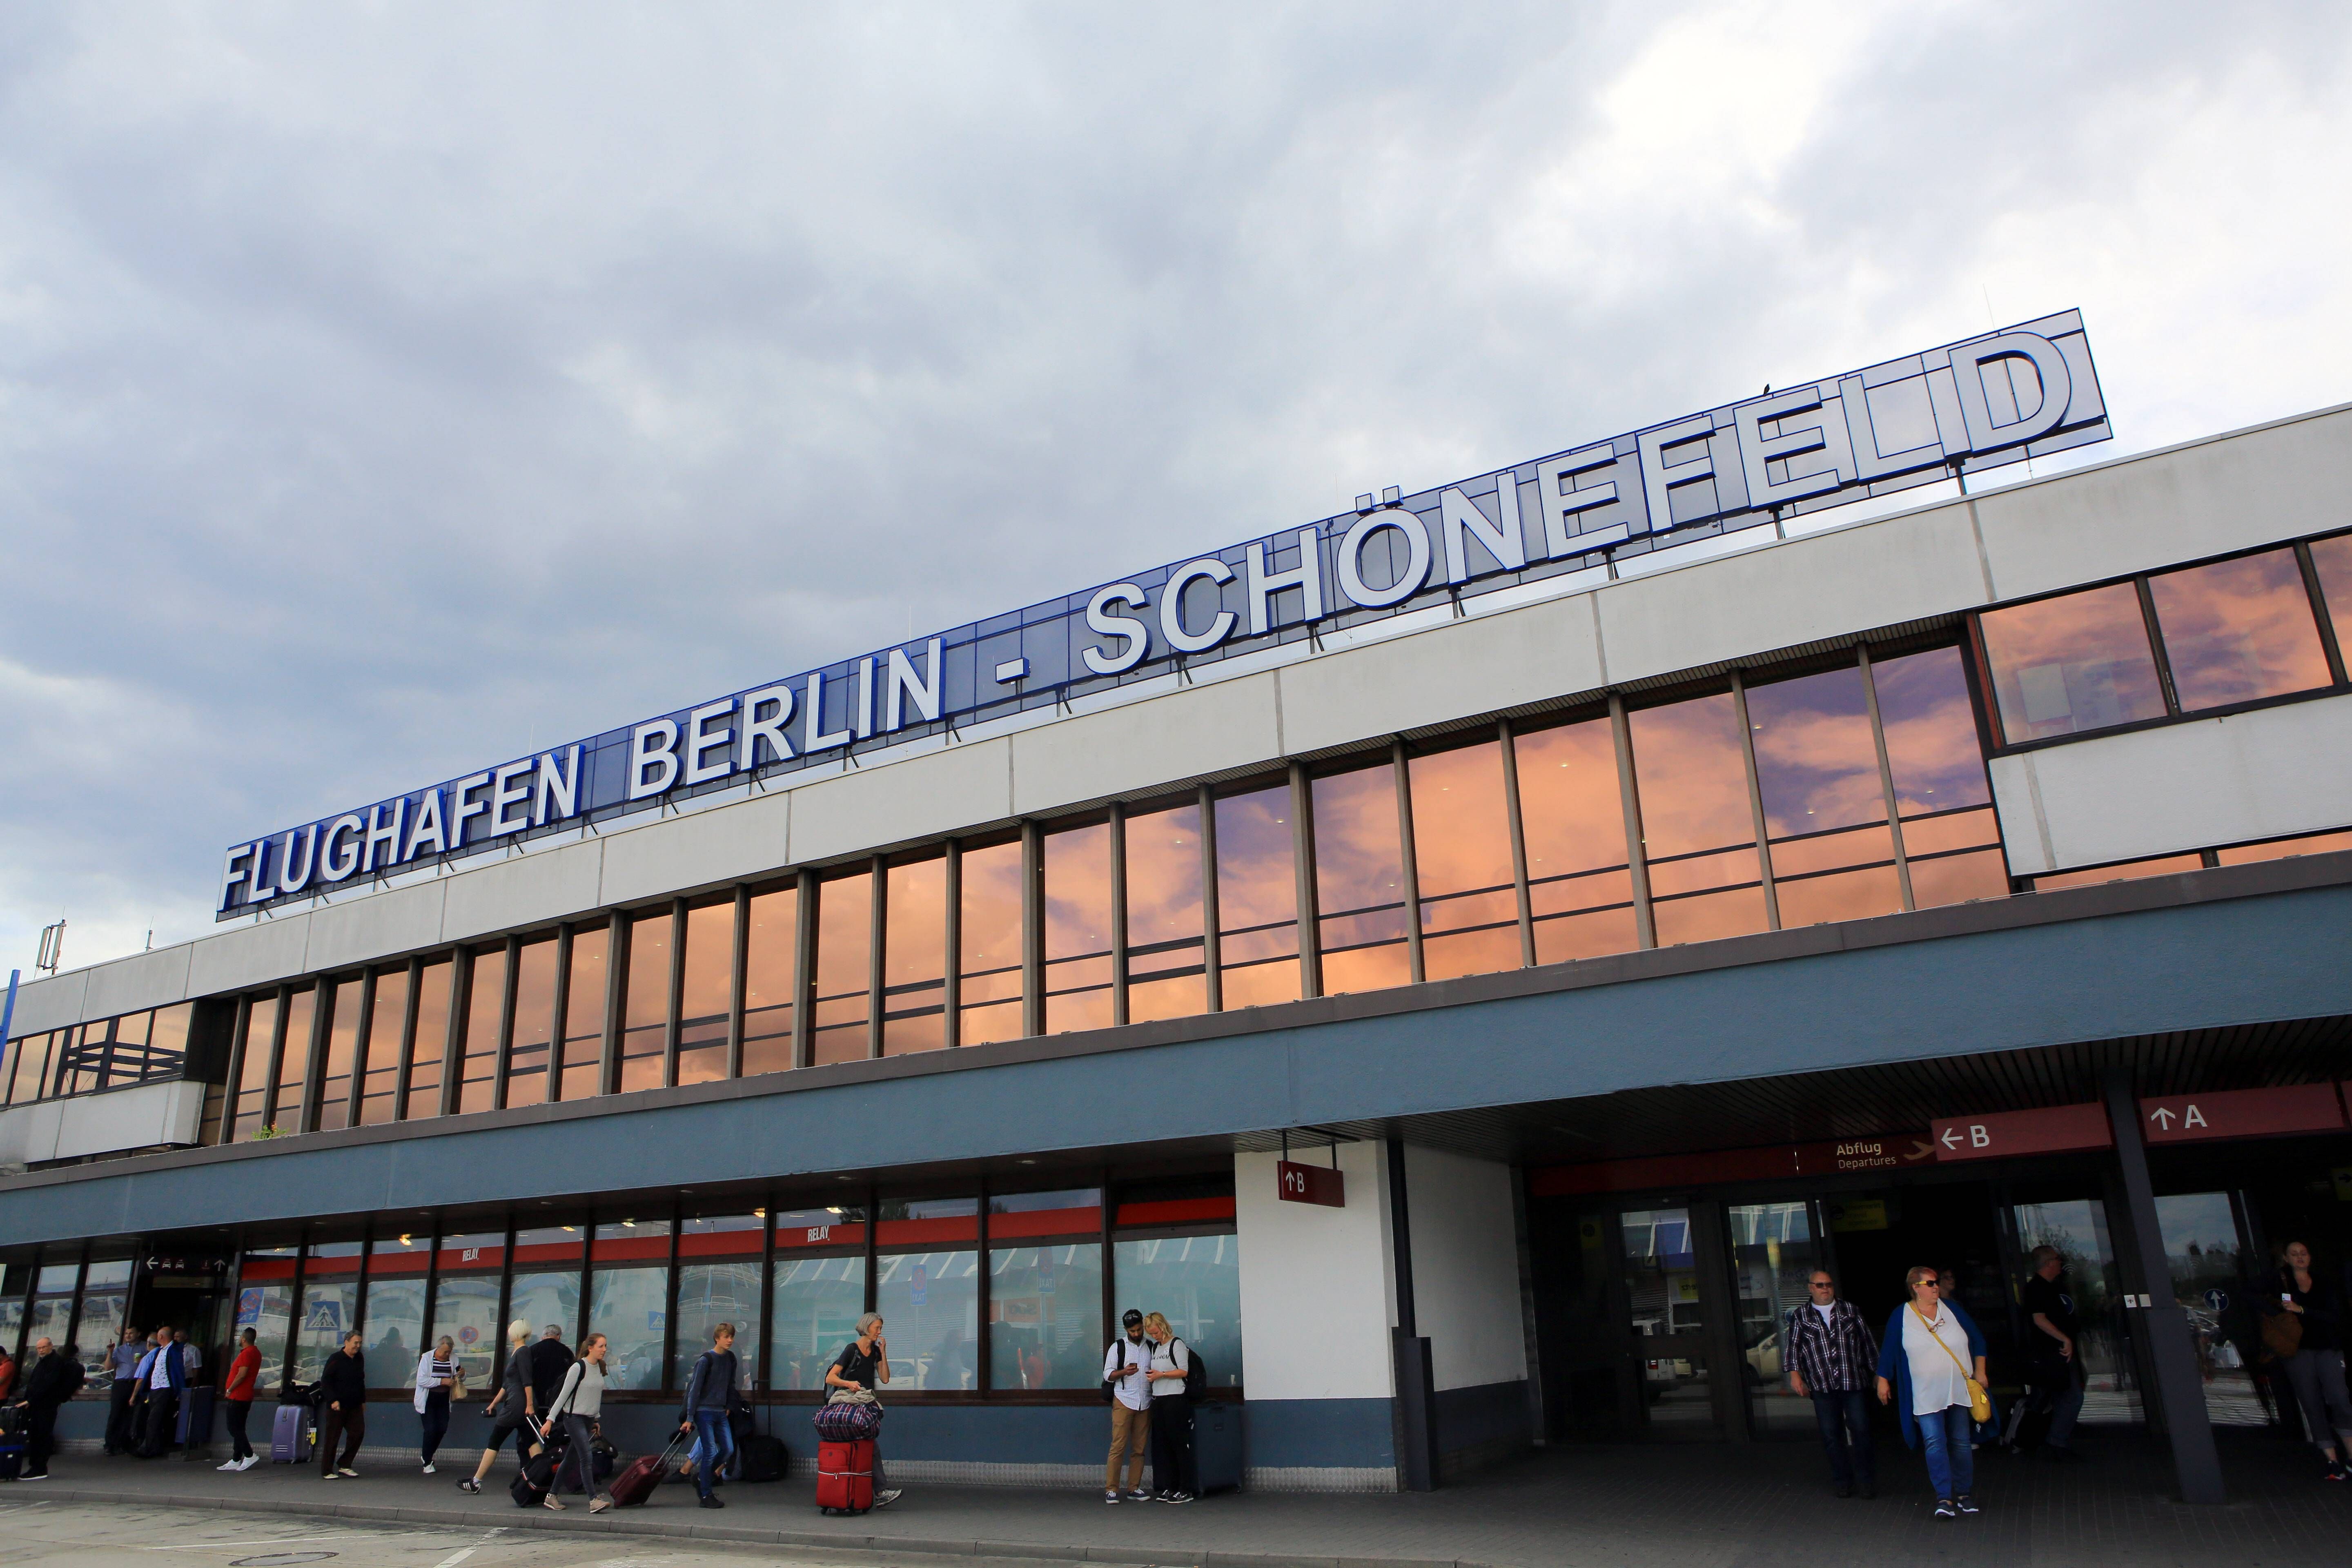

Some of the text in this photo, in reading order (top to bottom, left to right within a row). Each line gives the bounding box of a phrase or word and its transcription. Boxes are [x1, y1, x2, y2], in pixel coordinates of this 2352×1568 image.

[217, 331, 2071, 912] FLUGHAFEN BERLIN - SCHÖNEFELD
[2185, 1105, 2208, 1129] A
[1970, 1125, 1990, 1148] B
[1837, 1142, 1882, 1156] Abflug
[1838, 1156, 1896, 1170] Departures
[1297, 1172, 1305, 1193] B
[808, 1225, 829, 1242] RELAY
[462, 1247, 479, 1262] RELAY
